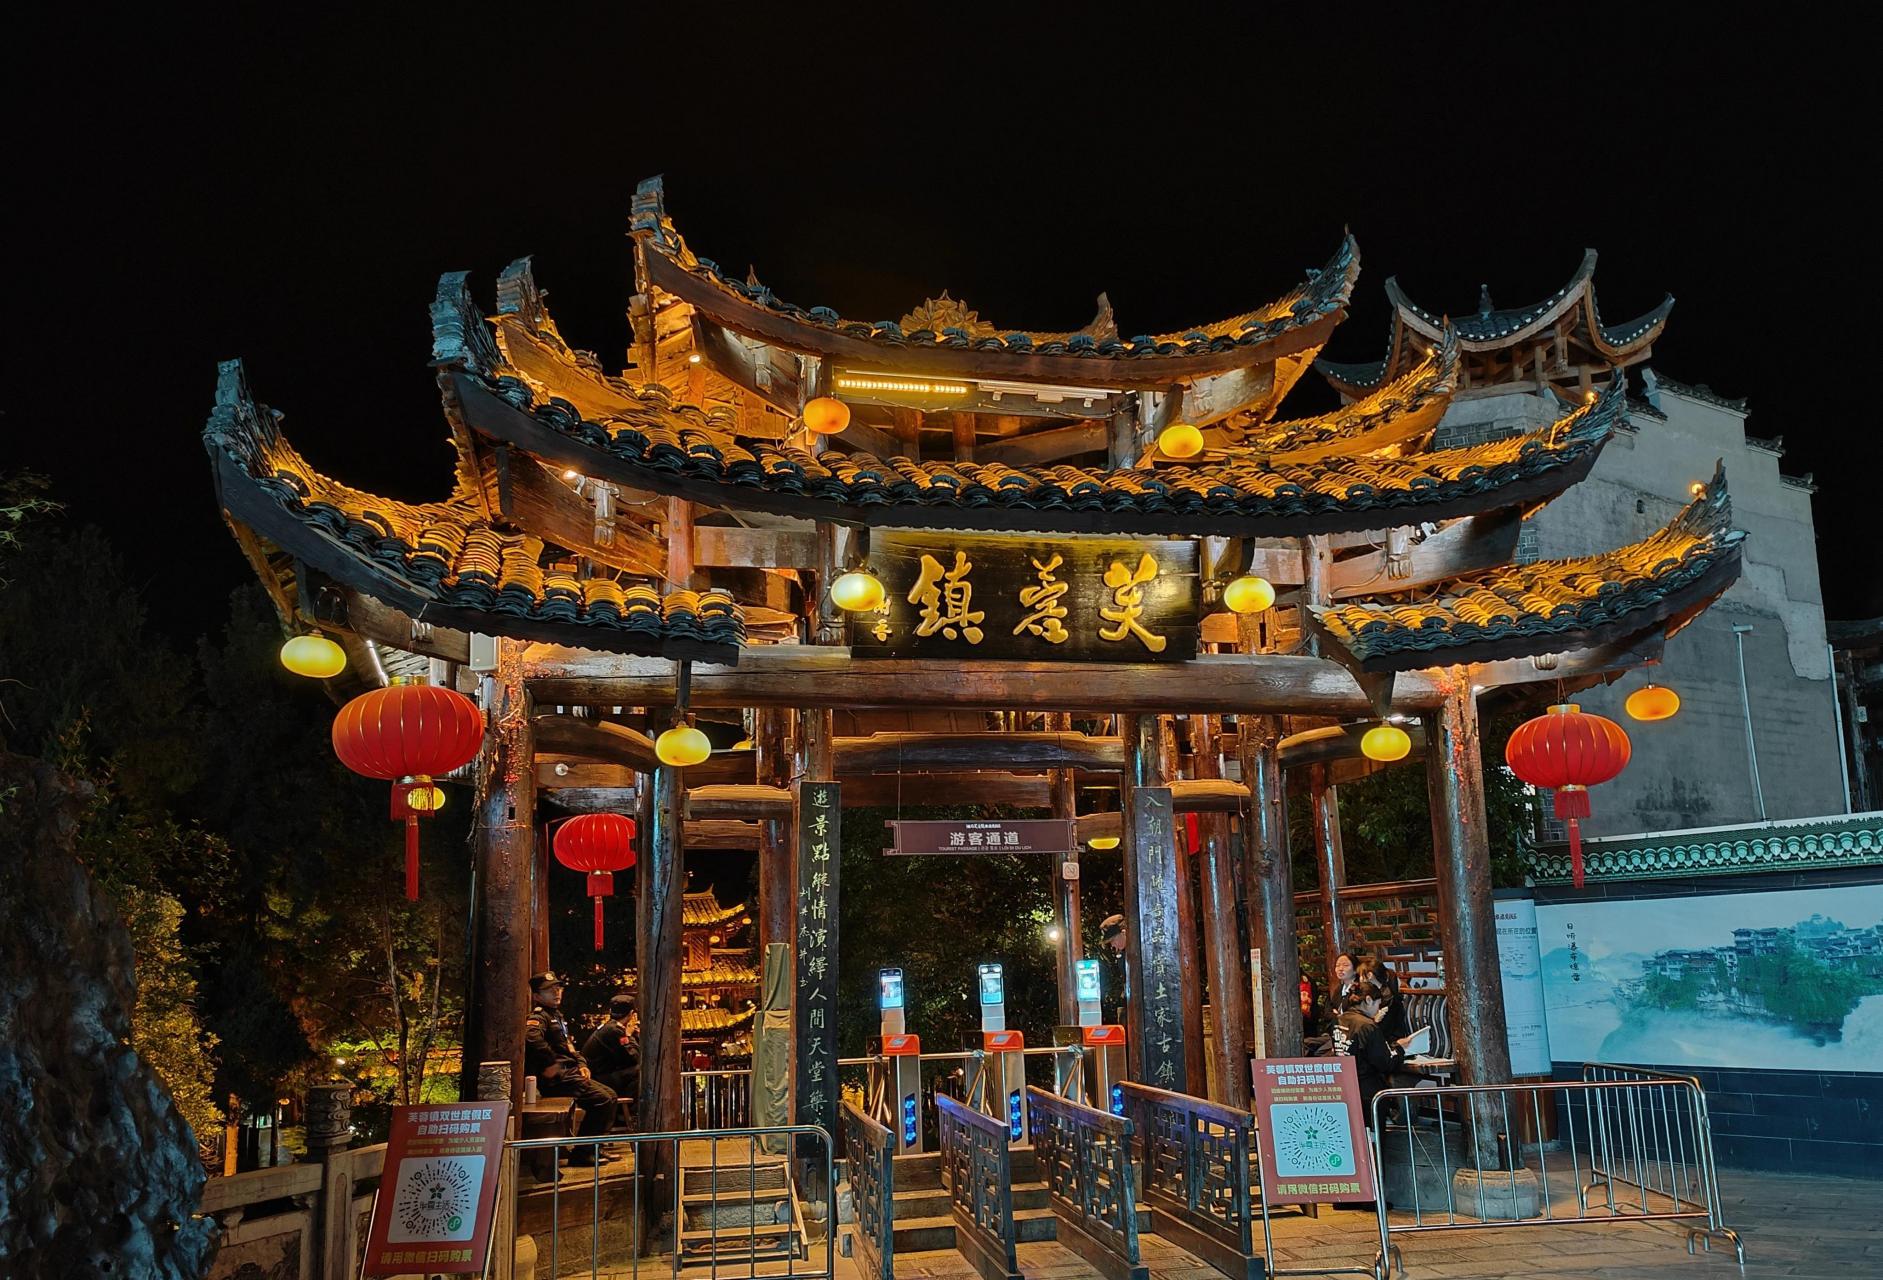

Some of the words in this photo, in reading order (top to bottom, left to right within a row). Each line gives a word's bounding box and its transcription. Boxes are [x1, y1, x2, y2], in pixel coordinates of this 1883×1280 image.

[950, 832, 1020, 846] 游客通道
[1278, 1075, 1335, 1085] 自助扫码购票
[417, 1123, 481, 1136] 自助扫码购票
[1277, 1182, 1361, 1195] 请用微信扫码购票
[380, 1249, 473, 1265] 请用微信扫码购票
